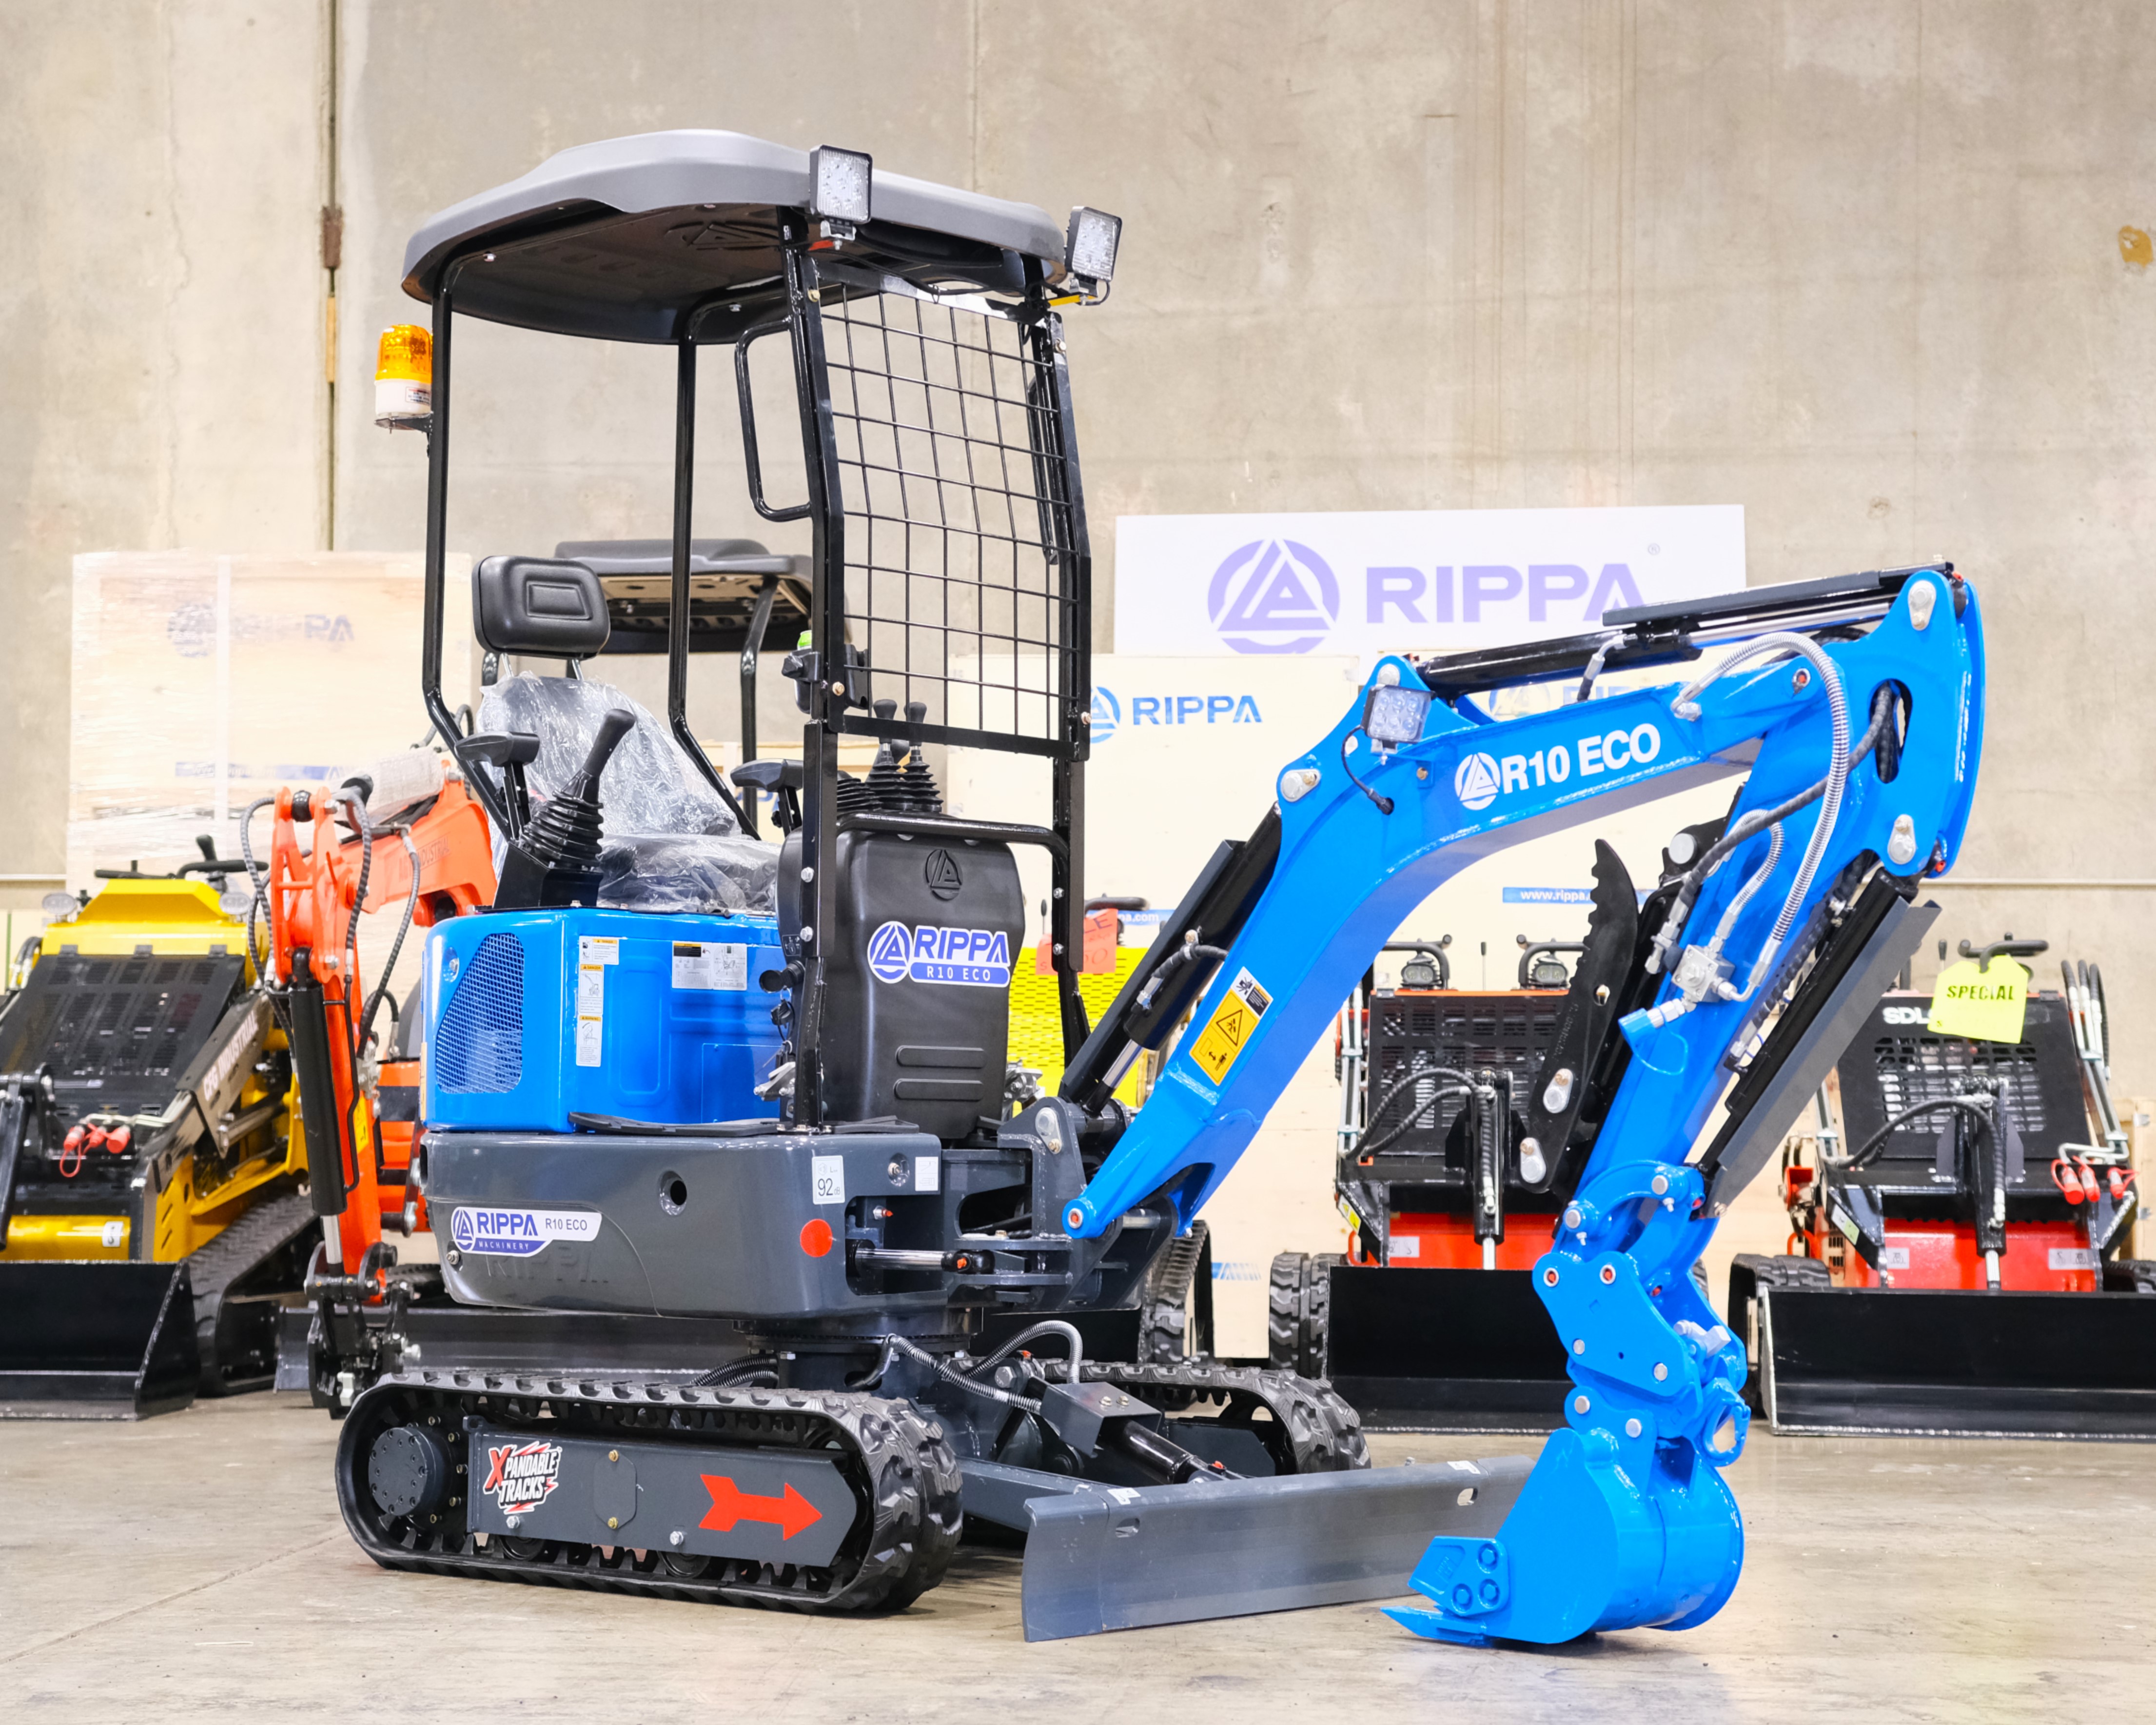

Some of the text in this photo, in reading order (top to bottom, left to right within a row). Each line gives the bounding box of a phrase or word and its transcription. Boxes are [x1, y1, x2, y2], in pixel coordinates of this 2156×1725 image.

[1367, 563, 1646, 623] RIPPA
[1133, 695, 1262, 725] RIPPA
[1501, 723, 1661, 794] R10 ECO
[1520, 891, 1591, 903] www.rippa.
[914, 928, 1008, 963] RIPPA
[927, 966, 991, 981] R10 ECO
[1946, 986, 2014, 1000] SPECIAL
[1882, 1007, 1933, 1024] SDL
[818, 1178, 833, 1196] 92
[476, 1212, 588, 1236] RIPPA R10 ECO
[479, 1241, 529, 1250] MACHINERY
[485, 1447, 557, 1489] XPANDABLE
[500, 1476, 545, 1503] TRACKS
